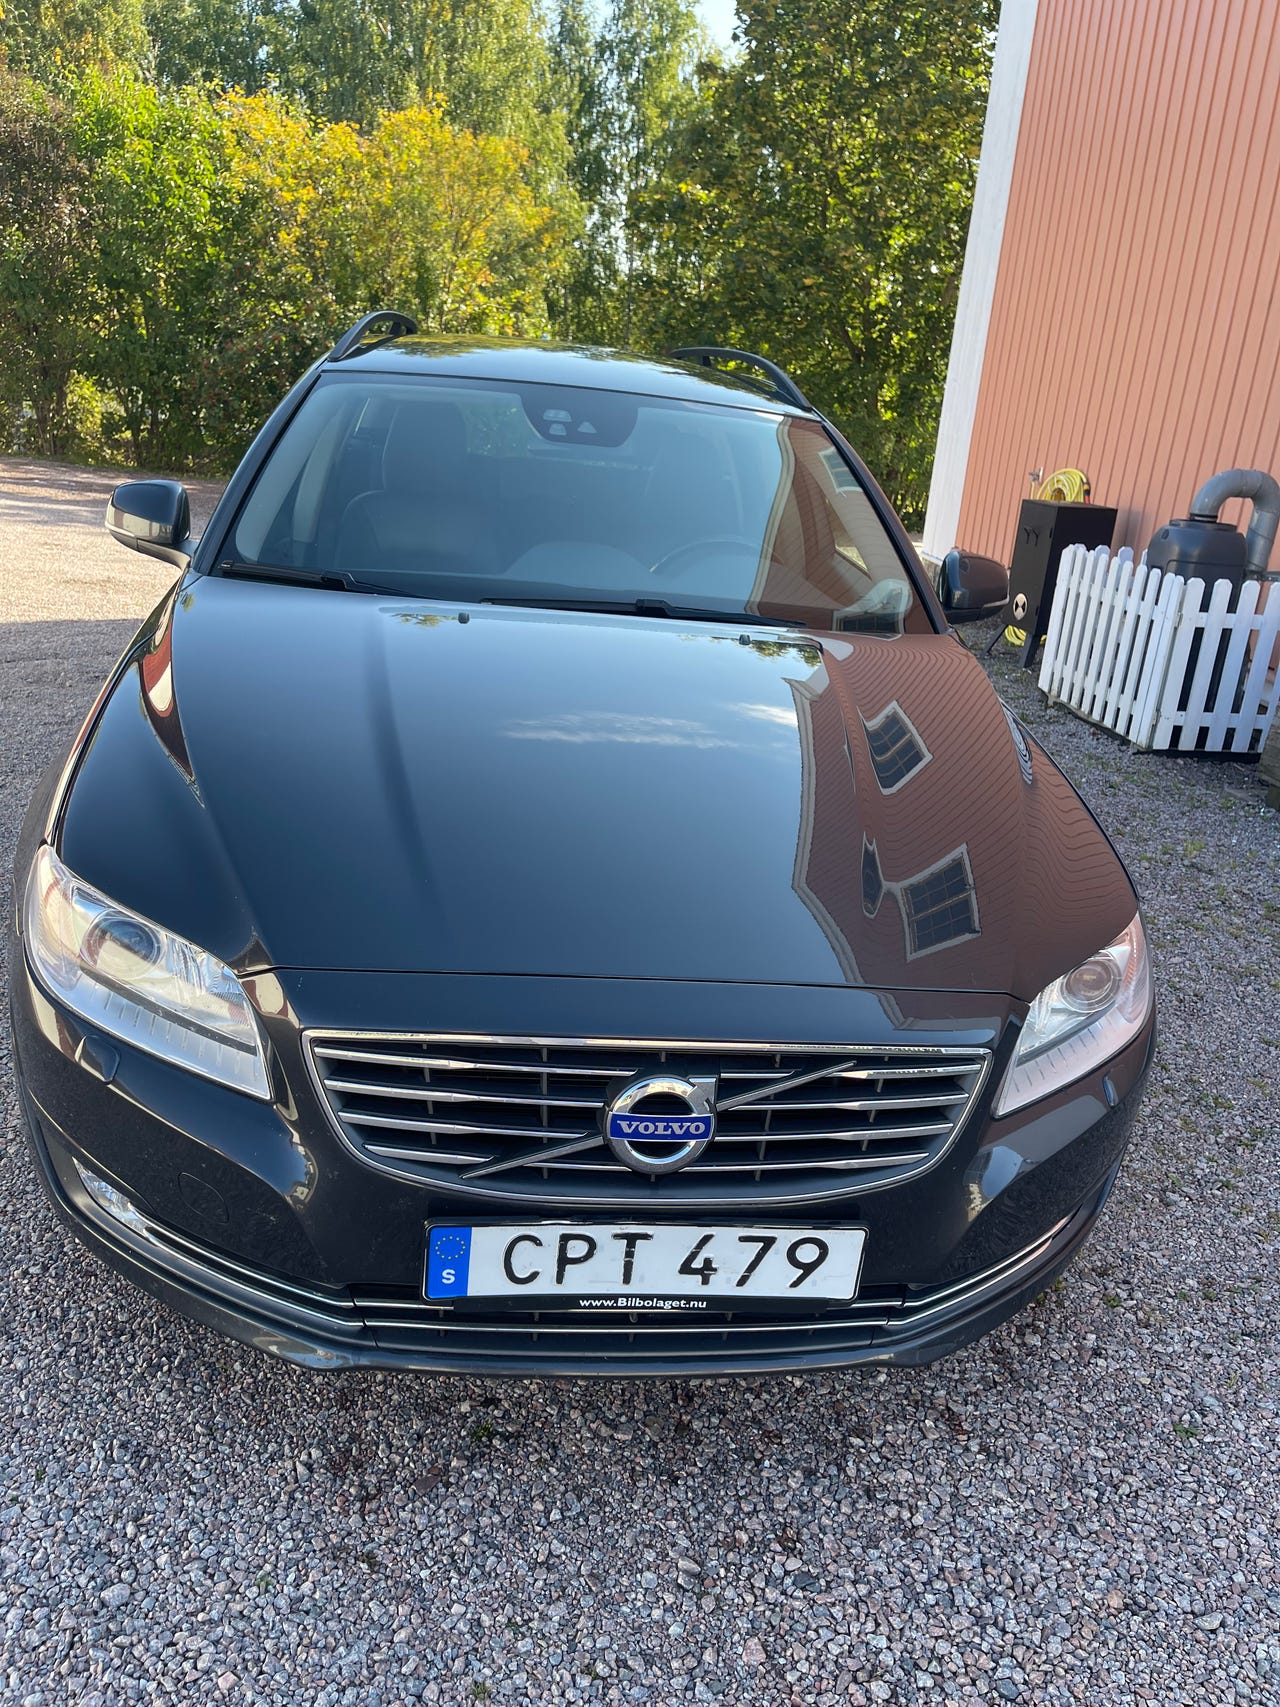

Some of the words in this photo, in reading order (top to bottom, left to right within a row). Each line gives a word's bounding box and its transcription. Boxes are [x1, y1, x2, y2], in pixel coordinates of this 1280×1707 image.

[617, 1120, 705, 1135] VOLVO
[502, 1232, 654, 1286] CPT
[677, 1233, 829, 1288] 479
[441, 1269, 455, 1285] S
[579, 1297, 707, 1310] www.Bilbolaget.nu
